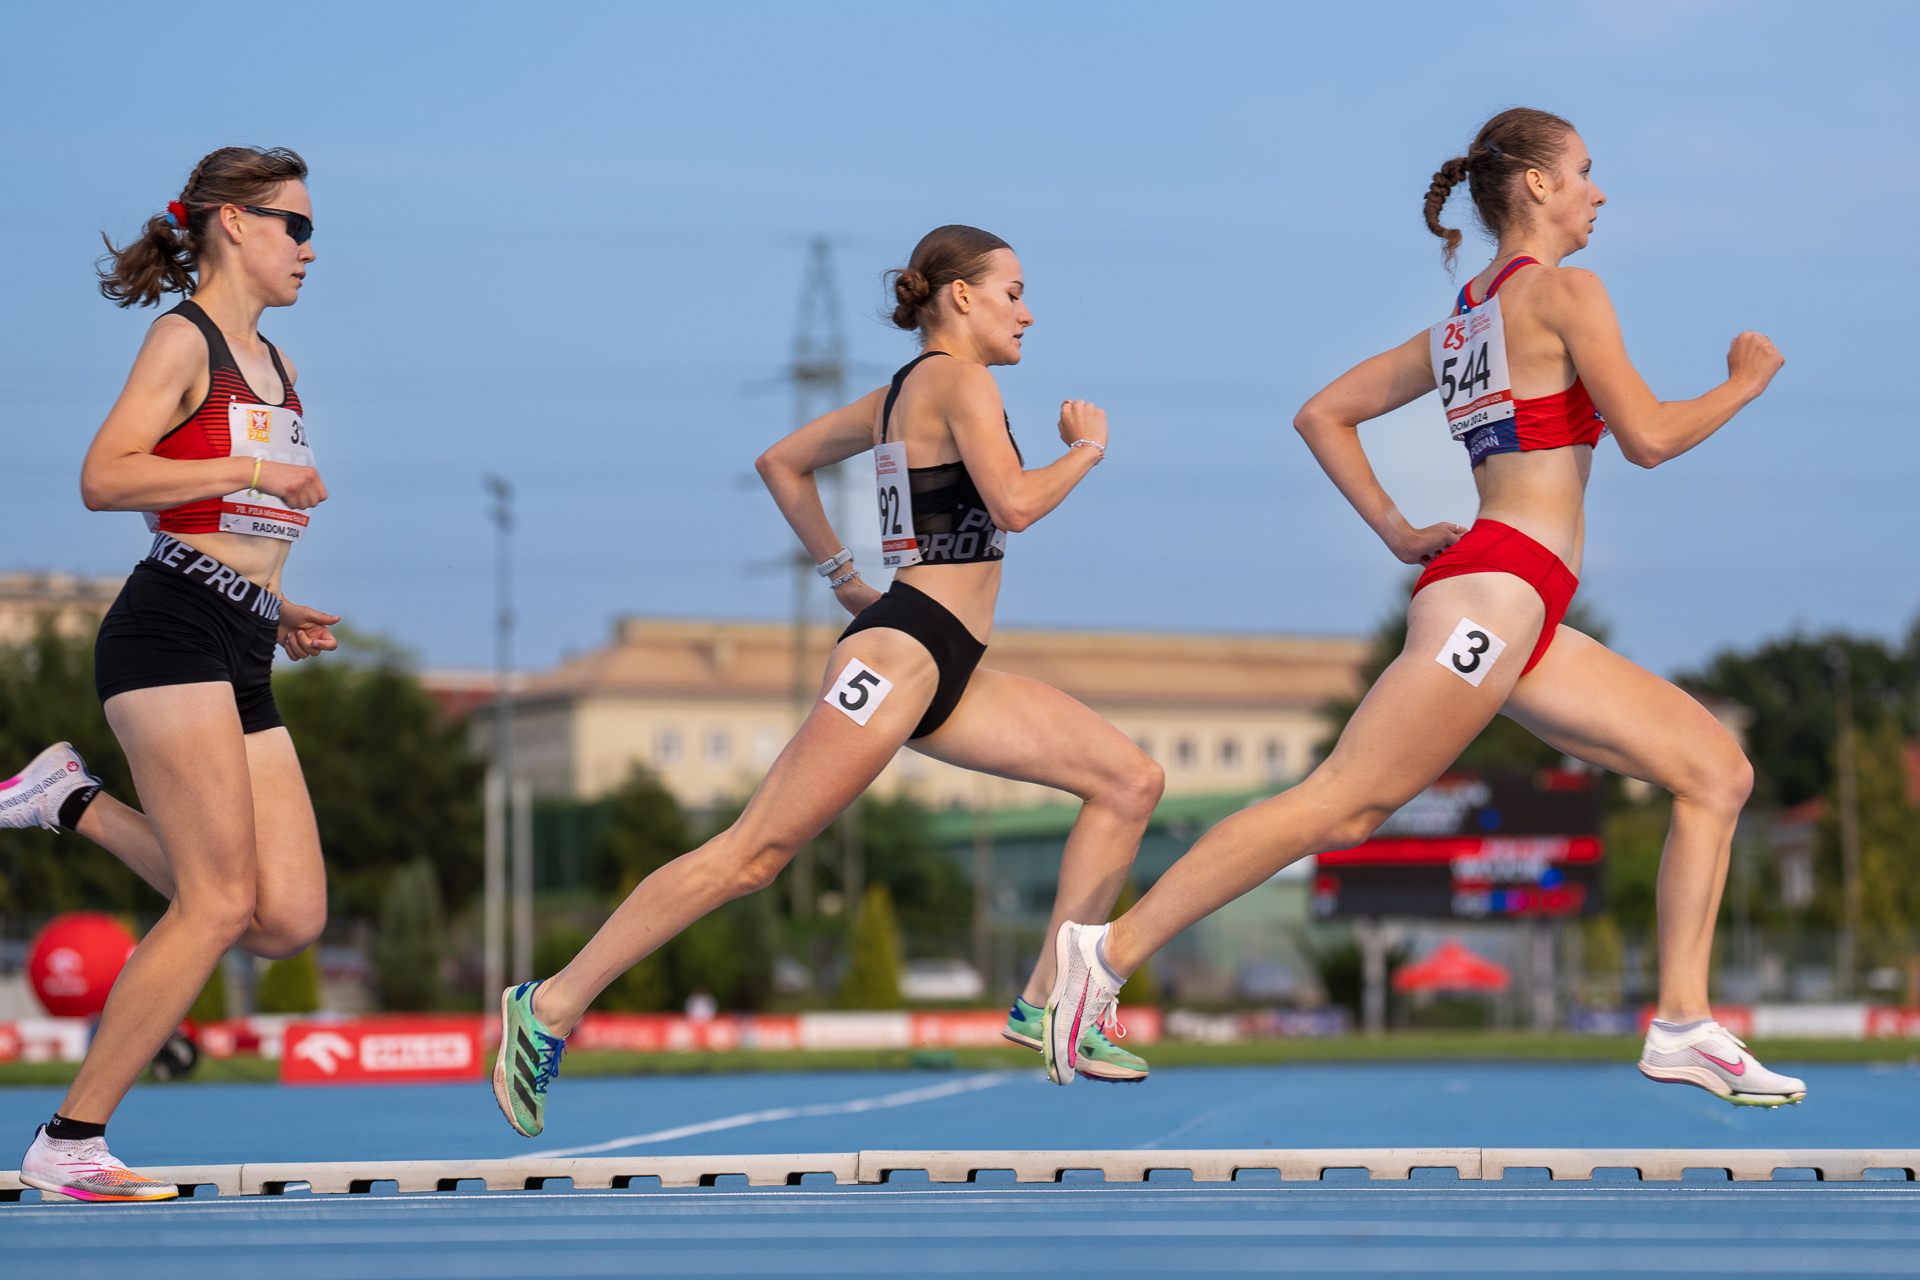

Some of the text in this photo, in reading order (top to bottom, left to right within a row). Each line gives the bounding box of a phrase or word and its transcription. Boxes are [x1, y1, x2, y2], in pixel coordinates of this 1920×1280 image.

[1442, 341, 1490, 408] 544
[252, 522, 285, 536] RADOM
[183, 554, 251, 602] PRO
[1452, 630, 1491, 674] 3
[839, 669, 881, 711] 5
